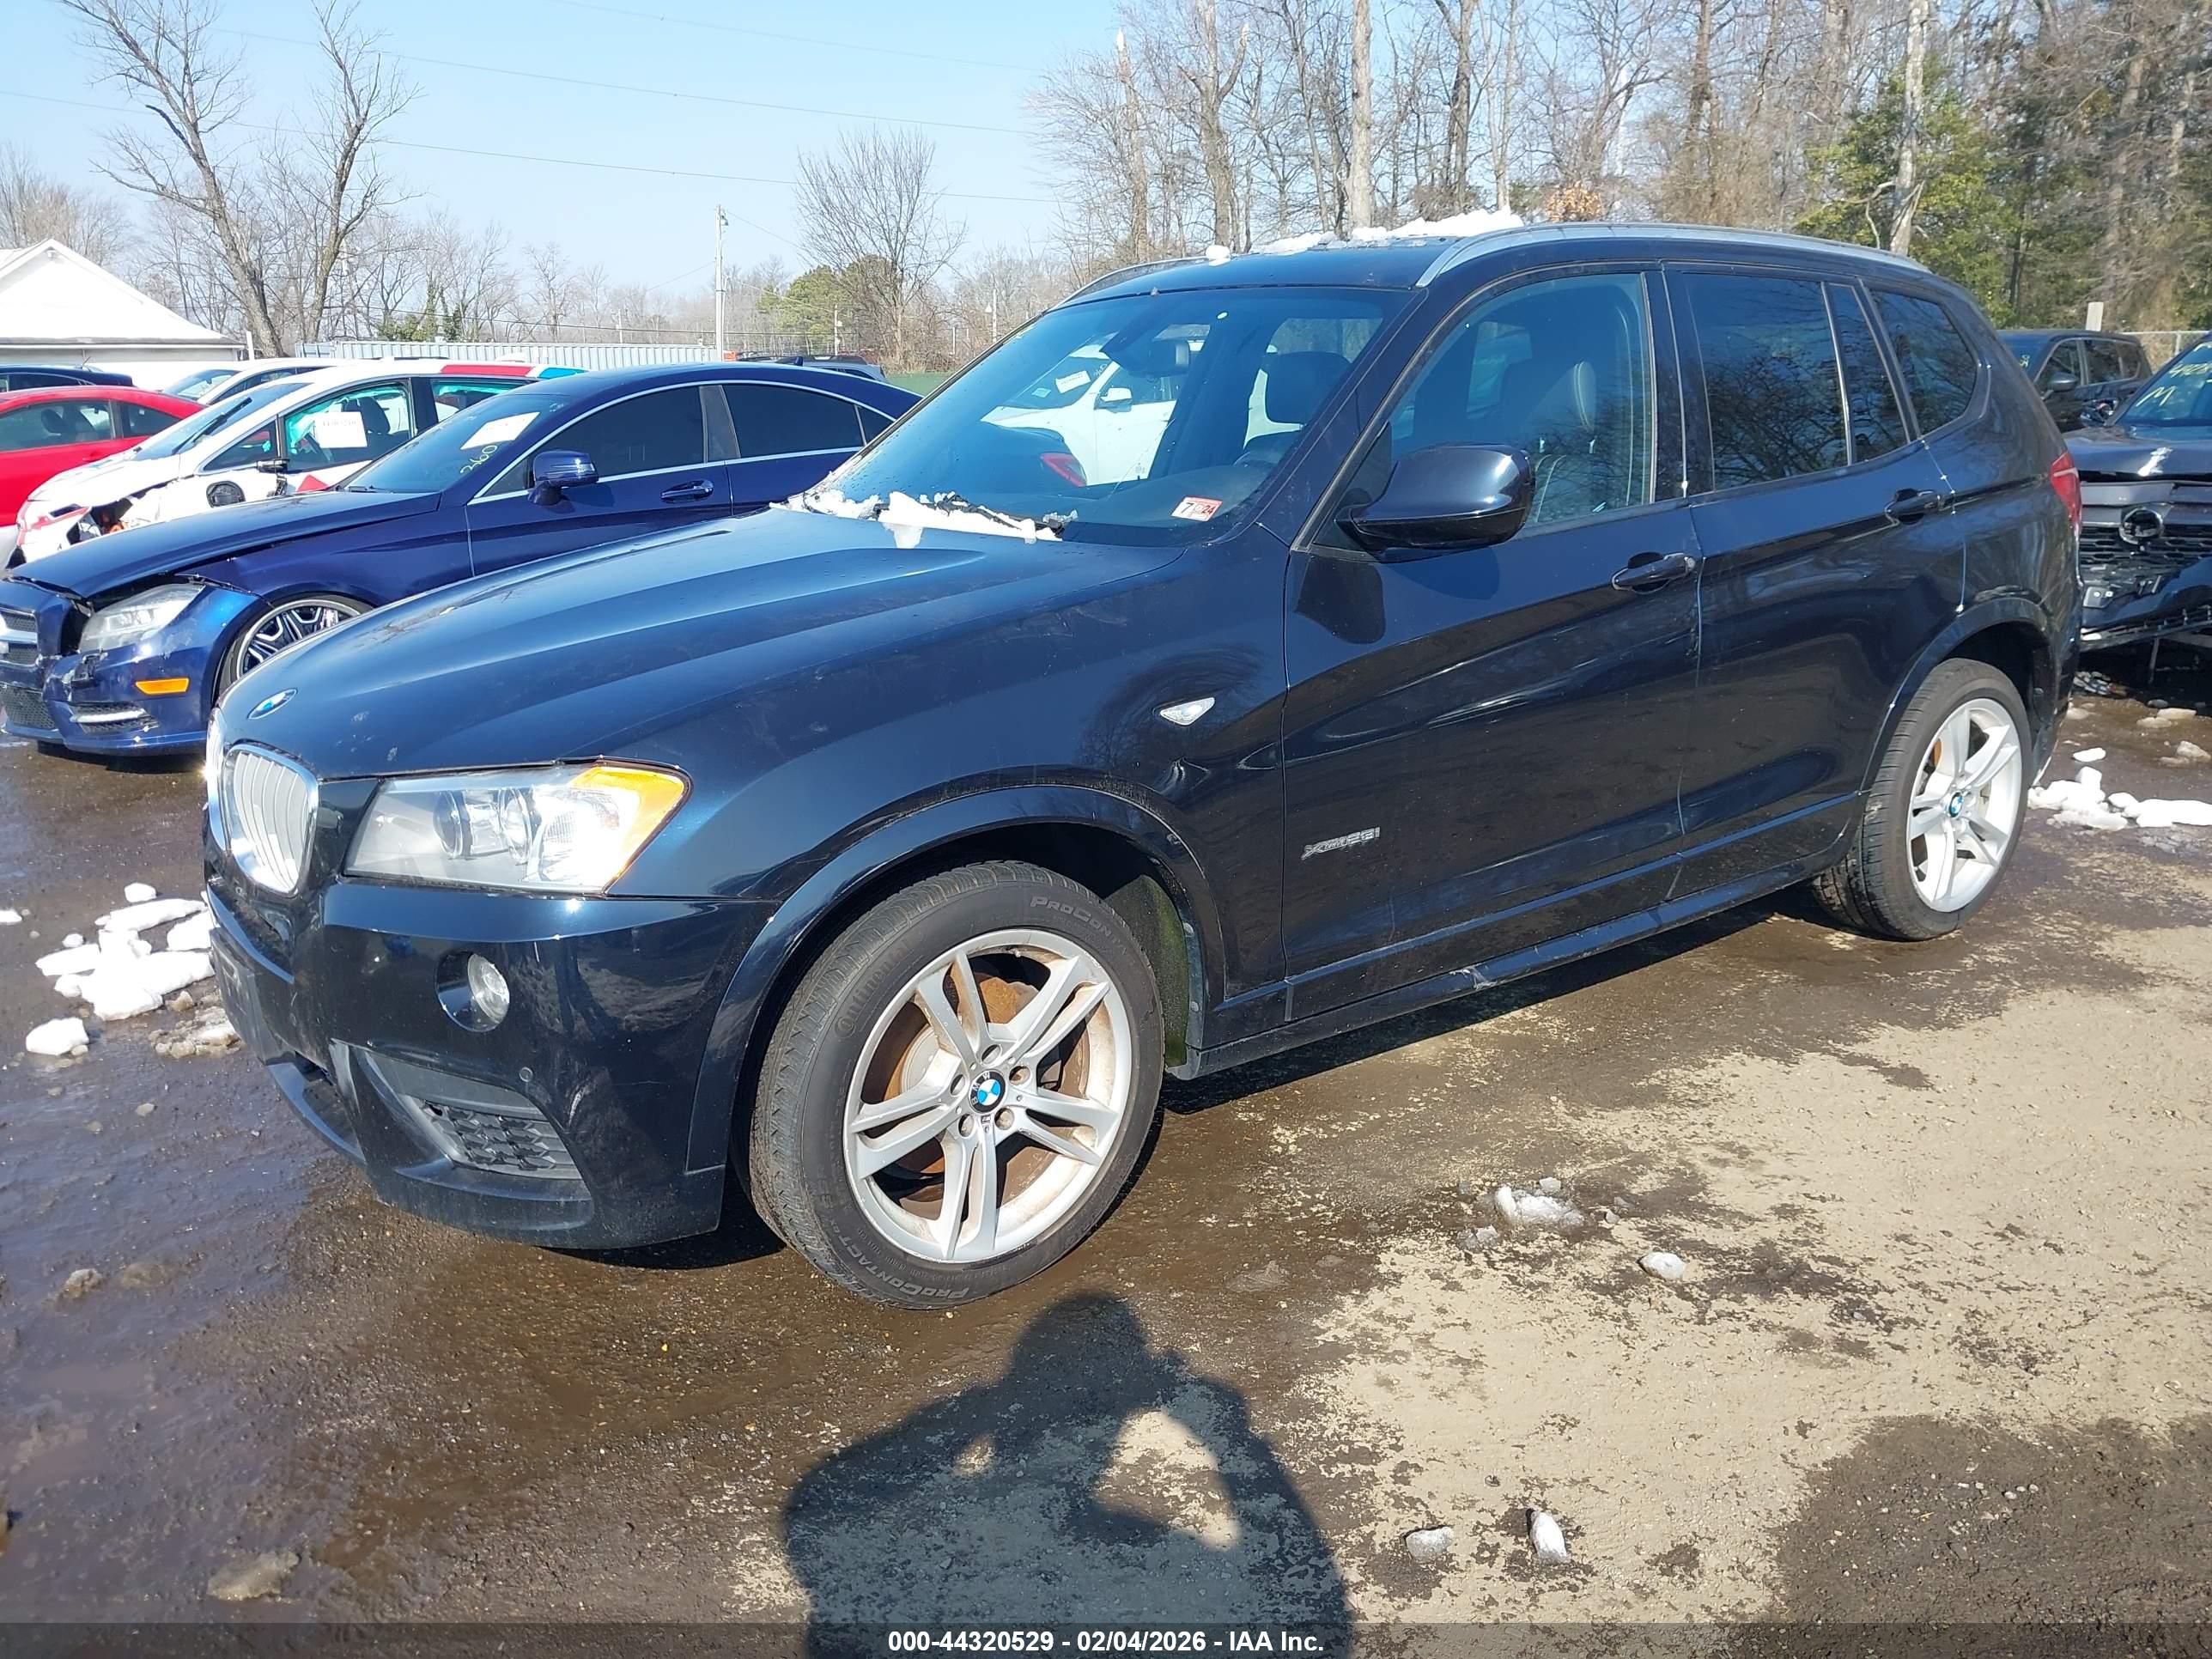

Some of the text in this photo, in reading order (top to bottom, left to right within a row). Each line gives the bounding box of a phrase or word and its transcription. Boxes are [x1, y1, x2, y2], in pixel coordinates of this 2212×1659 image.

[1181, 501, 1217, 515] 7 24
[970, 1071, 991, 1106] BMW
